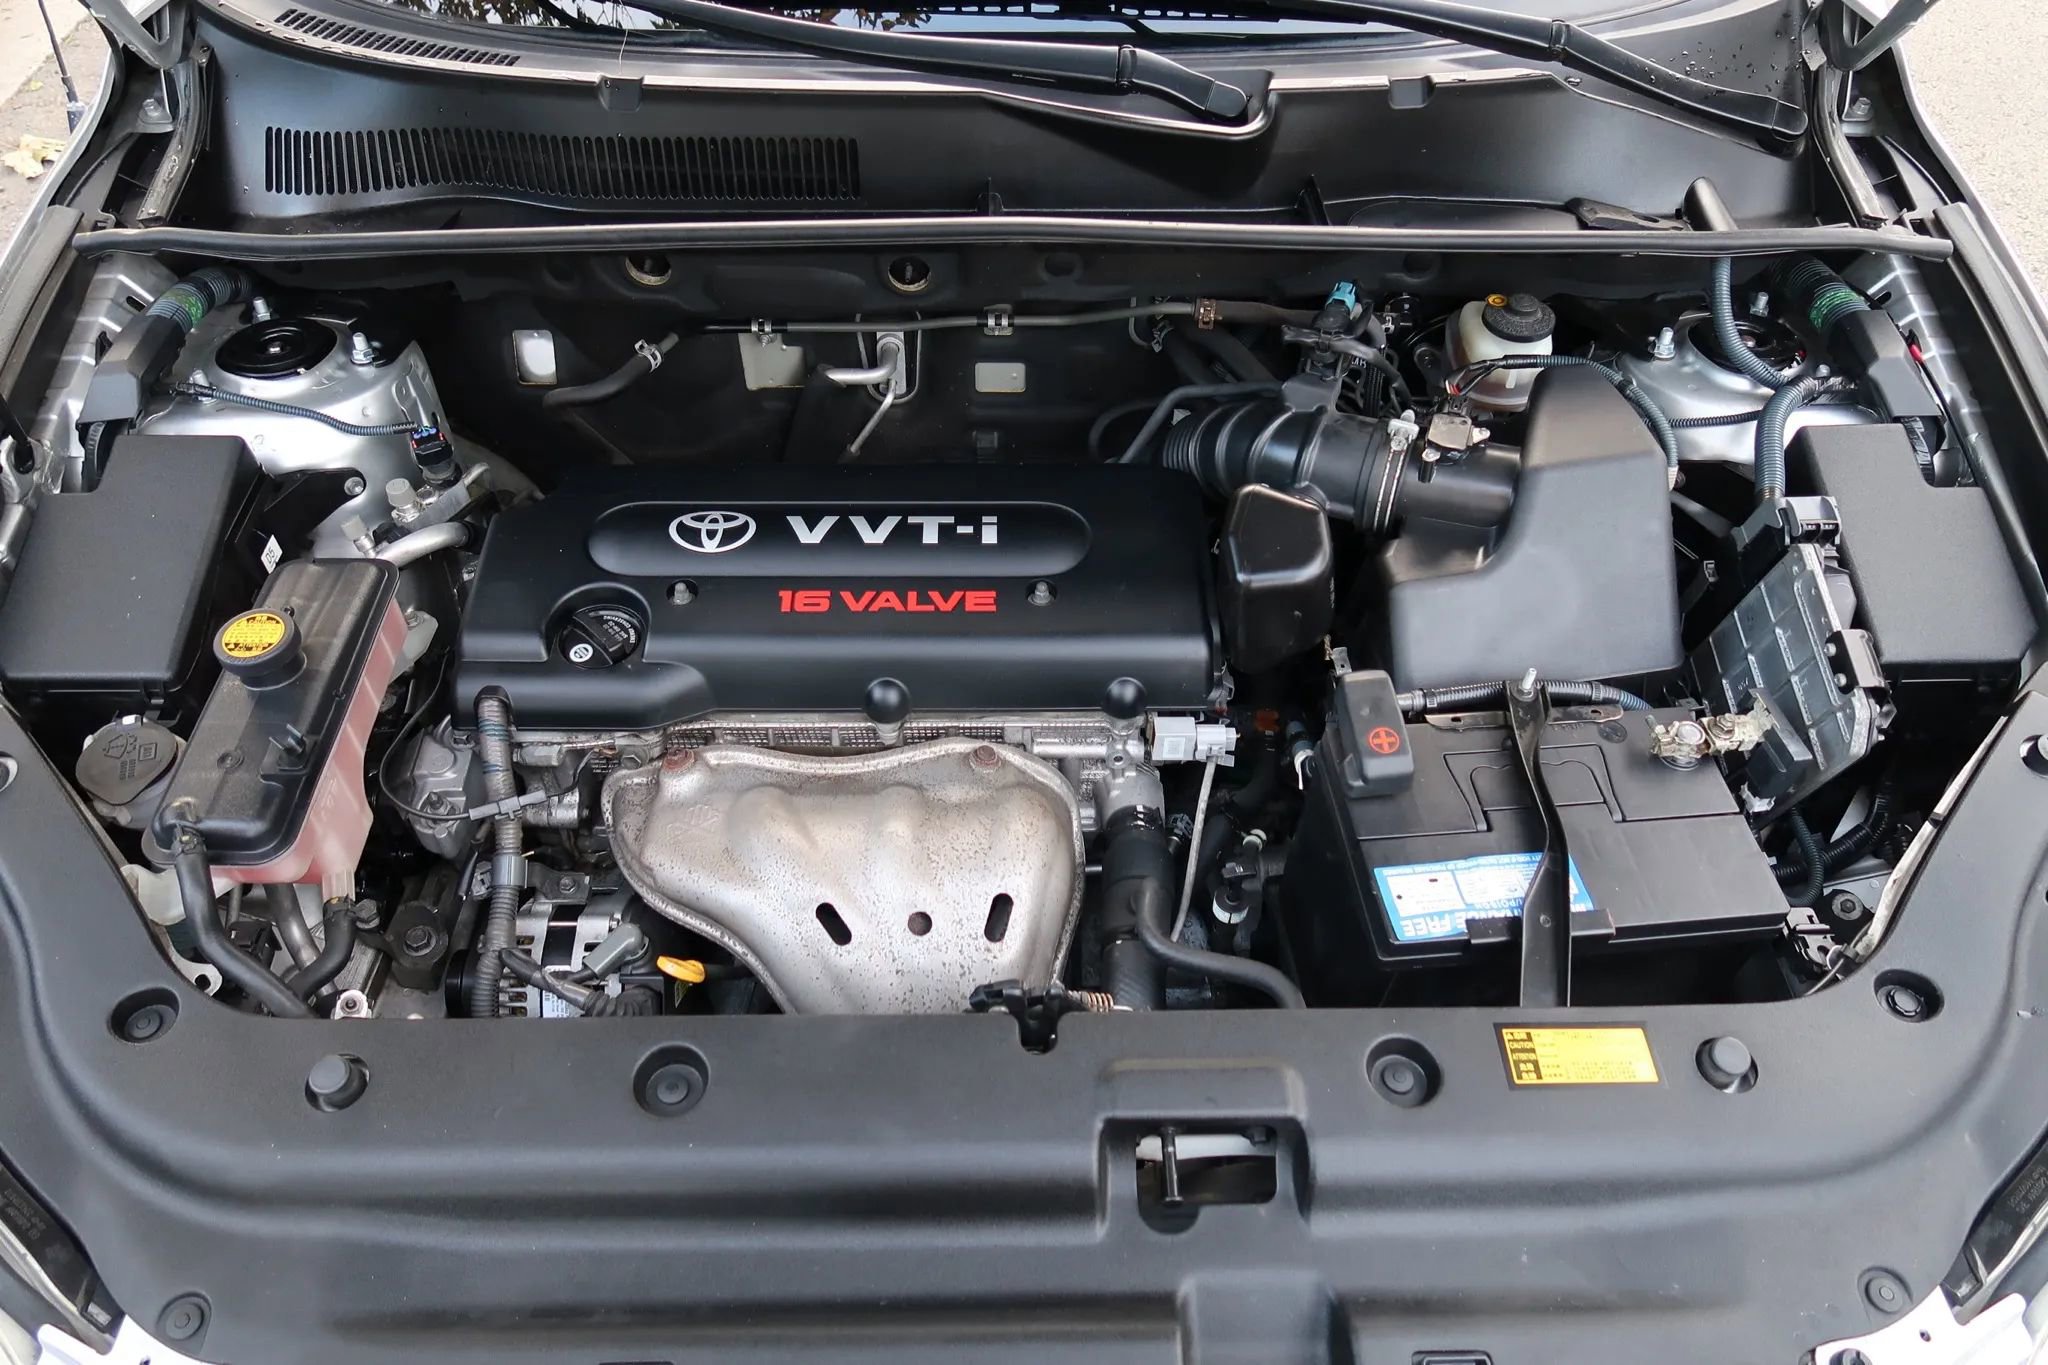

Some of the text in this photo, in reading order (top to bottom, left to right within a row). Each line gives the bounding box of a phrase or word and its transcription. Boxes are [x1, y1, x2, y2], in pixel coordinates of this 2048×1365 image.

[785, 515, 998, 544] VVT-i
[778, 590, 997, 613] 16 VALVE
[1402, 912, 1452, 937] FREE
